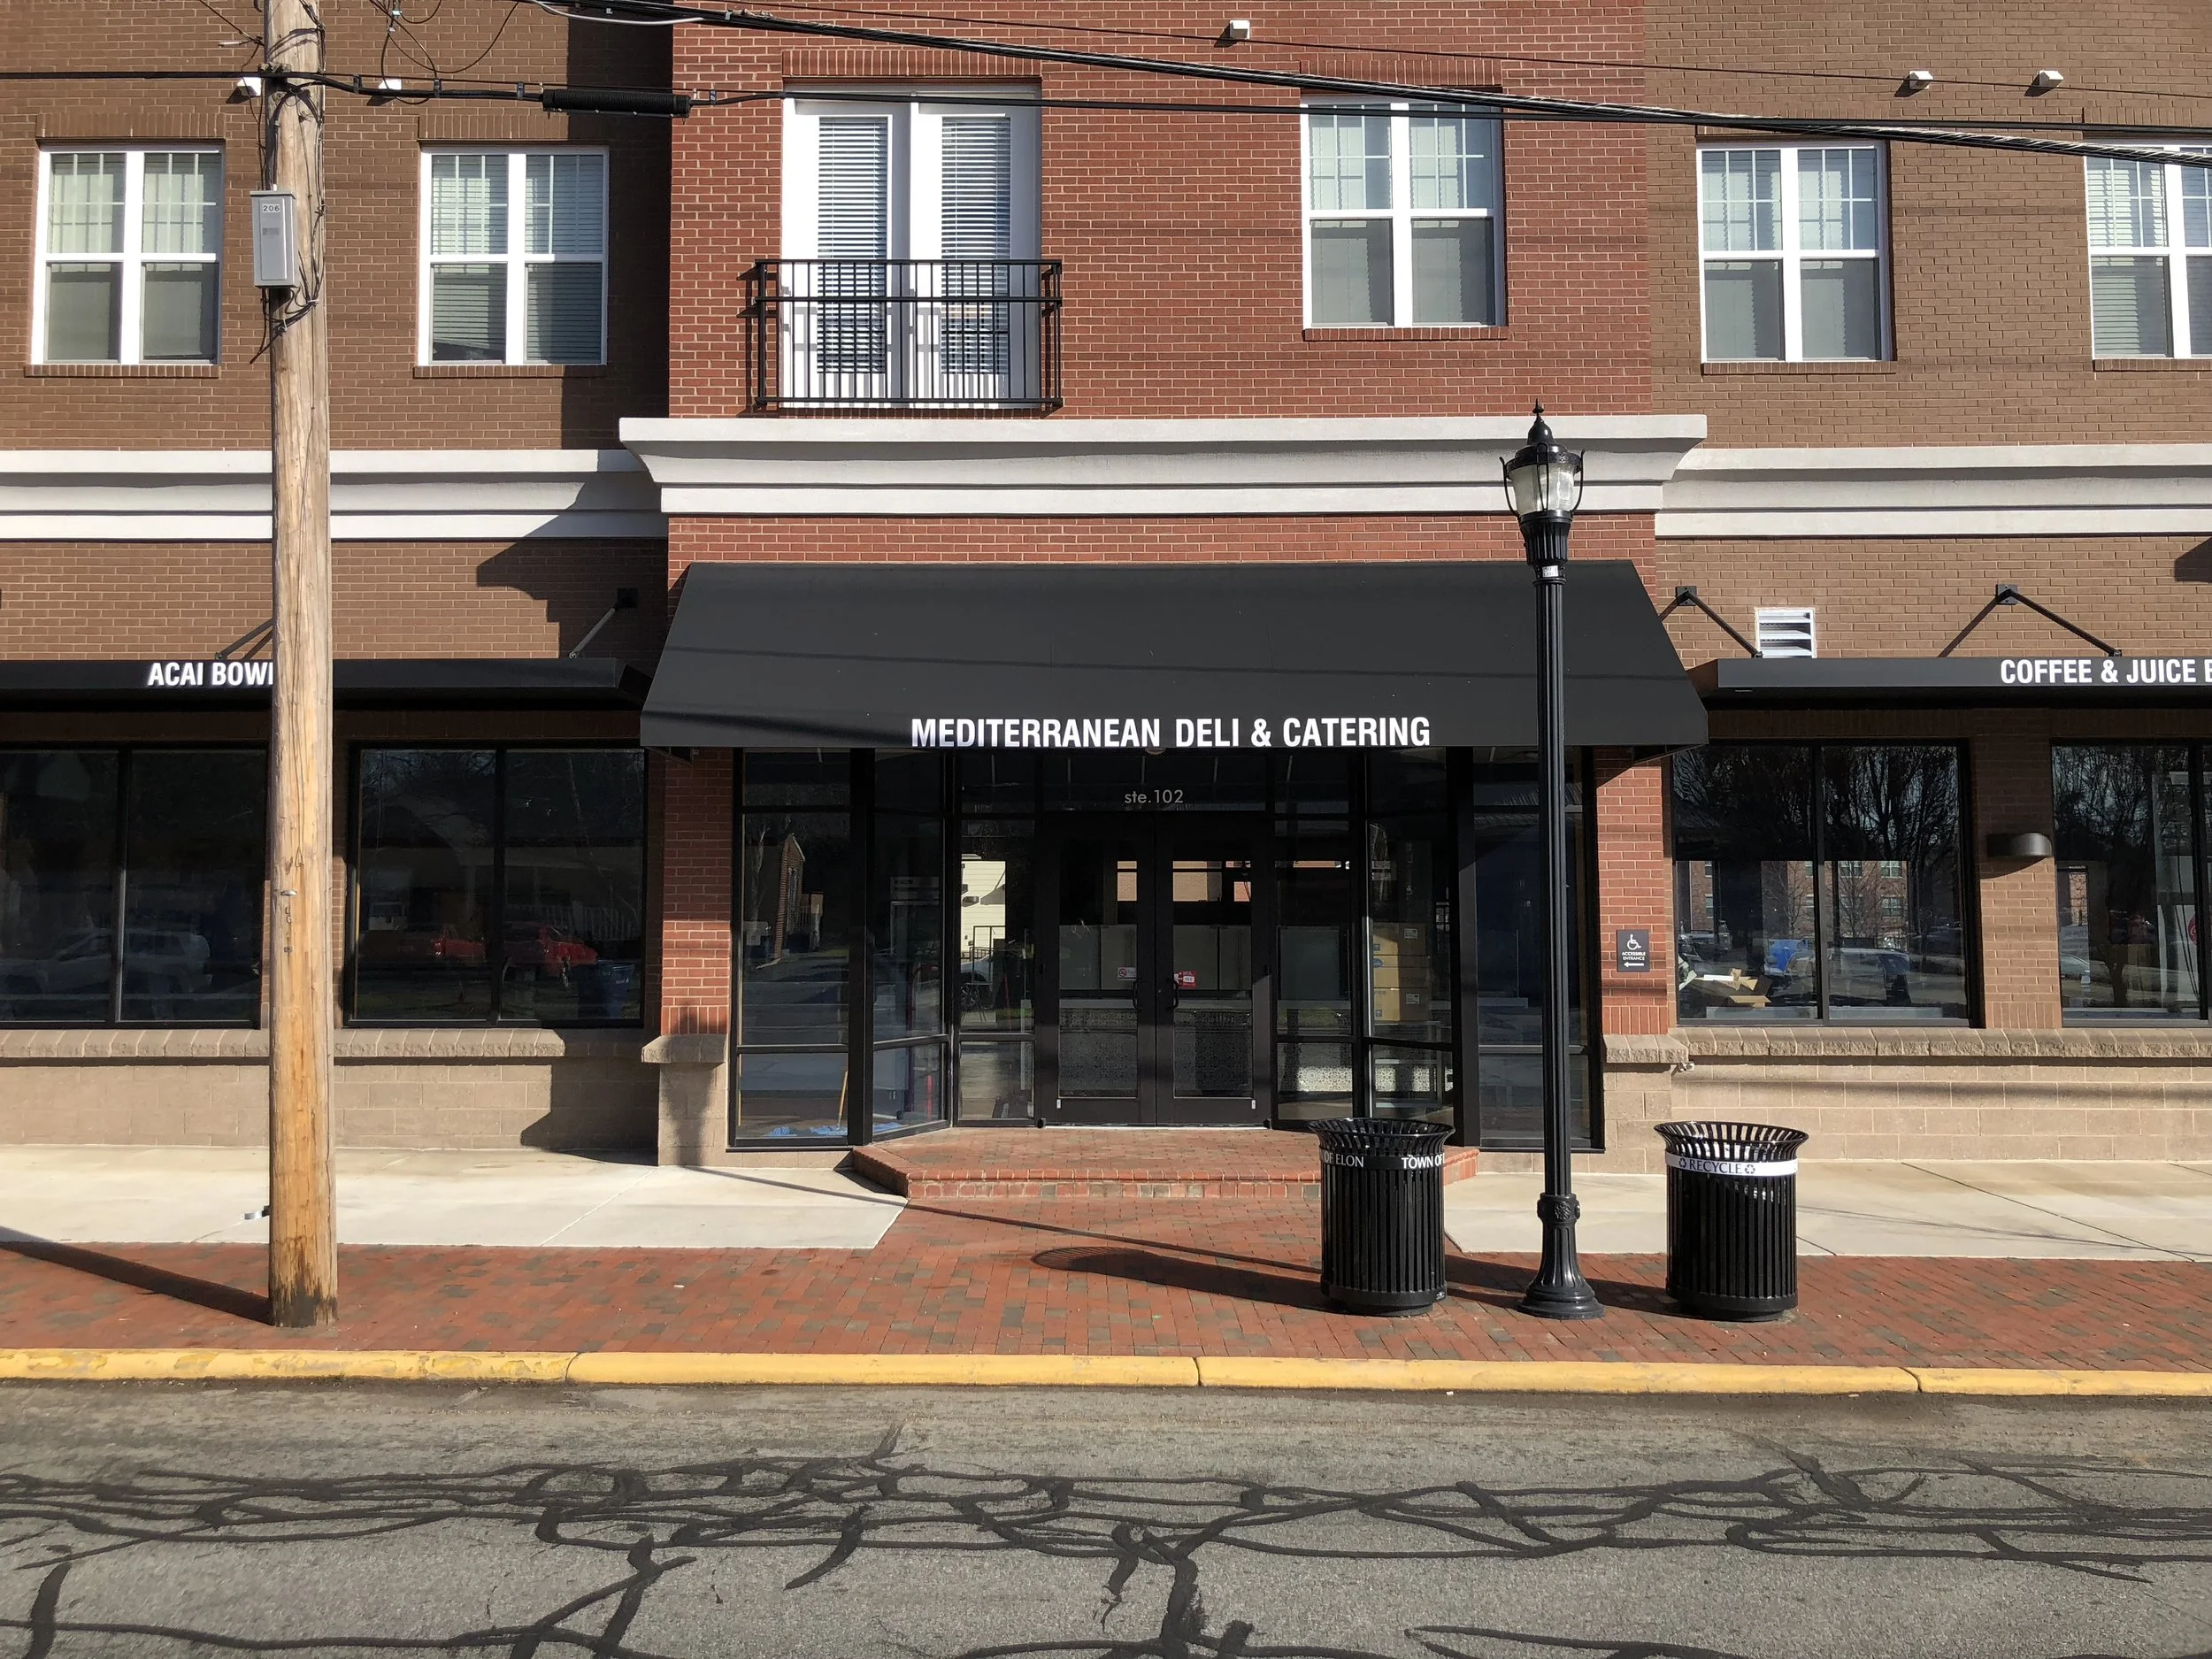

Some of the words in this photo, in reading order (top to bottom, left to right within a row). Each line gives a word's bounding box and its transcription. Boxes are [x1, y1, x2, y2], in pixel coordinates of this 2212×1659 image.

[148, 662, 204, 686] ACAI
[2001, 659, 2093, 684] COFFEE
[2101, 659, 2119, 684] &
[2126, 659, 2197, 684] JUICE
[911, 718, 1160, 747] MEDITERRANEAN
[1175, 718, 1240, 747] DELI
[1250, 718, 1272, 747] &
[1283, 717, 1431, 747] CATERING
[1324, 1150, 1333, 1164] OF
[1335, 1154, 1364, 1168] ELON
[1401, 1156, 1433, 1169] TOWN
[1689, 1159, 1743, 1174] RECYCLE
